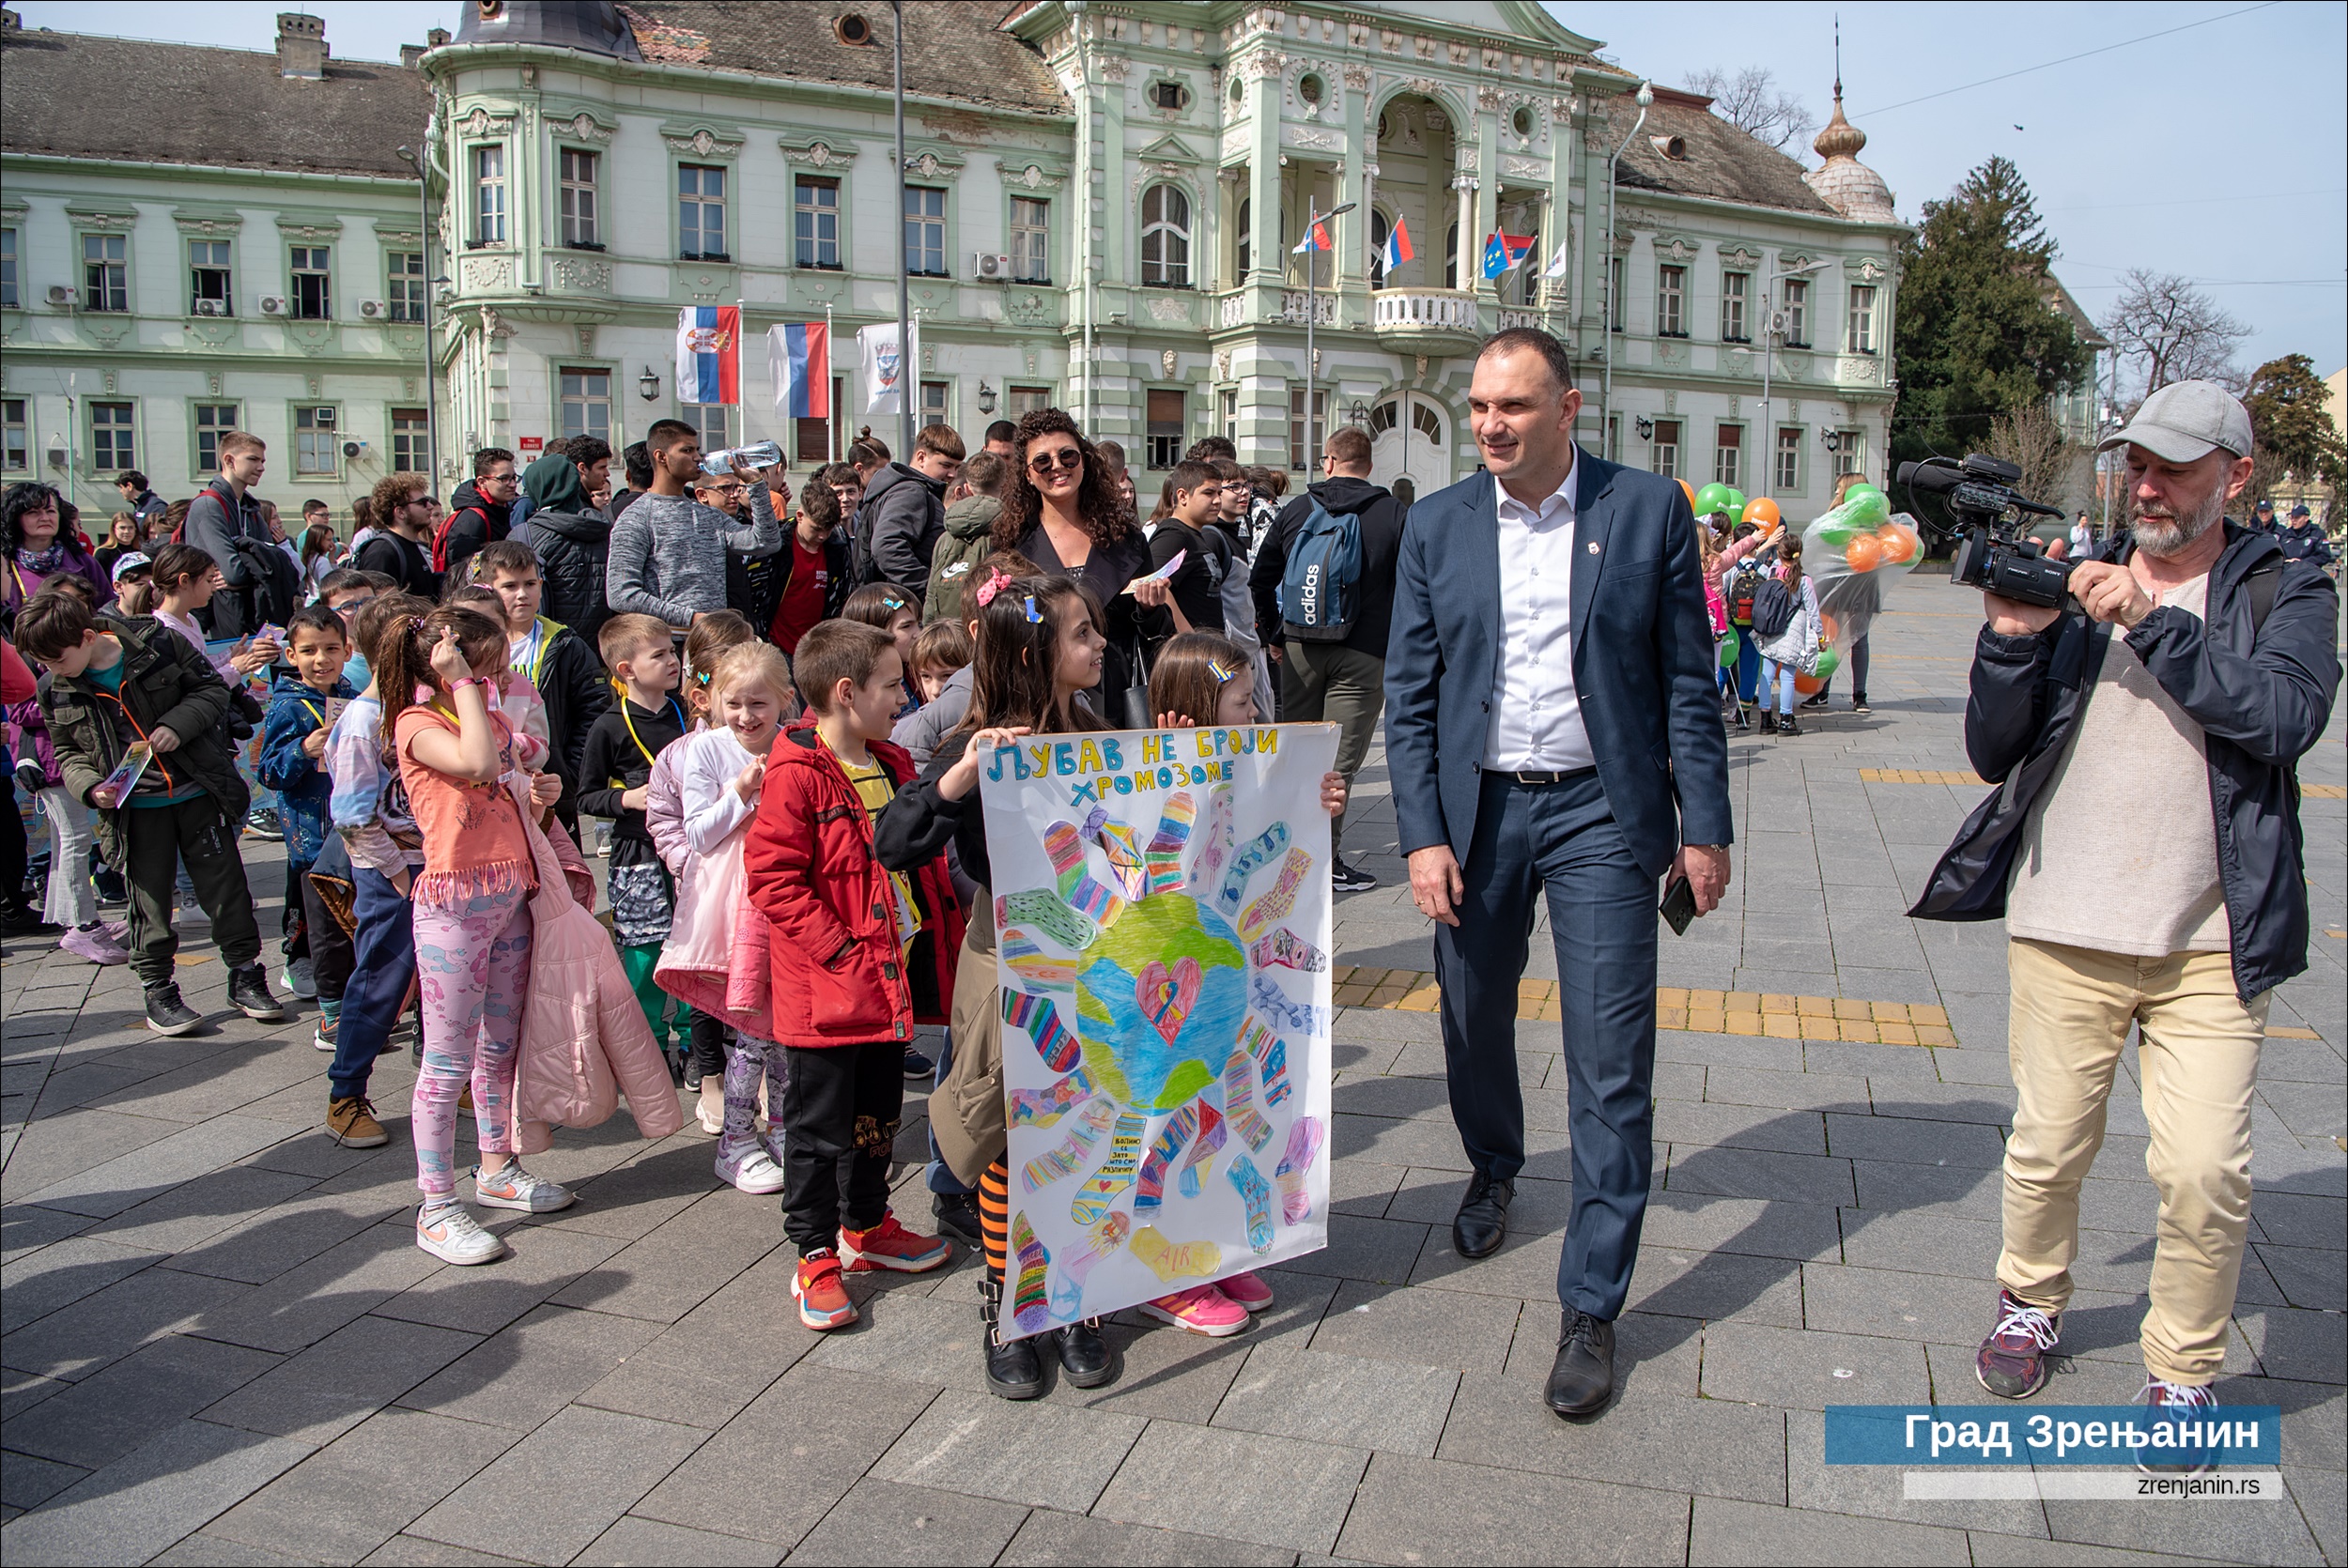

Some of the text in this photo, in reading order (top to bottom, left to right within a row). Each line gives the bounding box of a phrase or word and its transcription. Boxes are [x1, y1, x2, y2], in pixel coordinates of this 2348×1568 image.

[1301, 564, 1320, 625] adidas
[2044, 568, 2062, 576] SONY
[987, 729, 1278, 782] ЉУБАВ НЕ БРОЈИ
[1070, 761, 1234, 807] ХРОМОЗОМЕ
